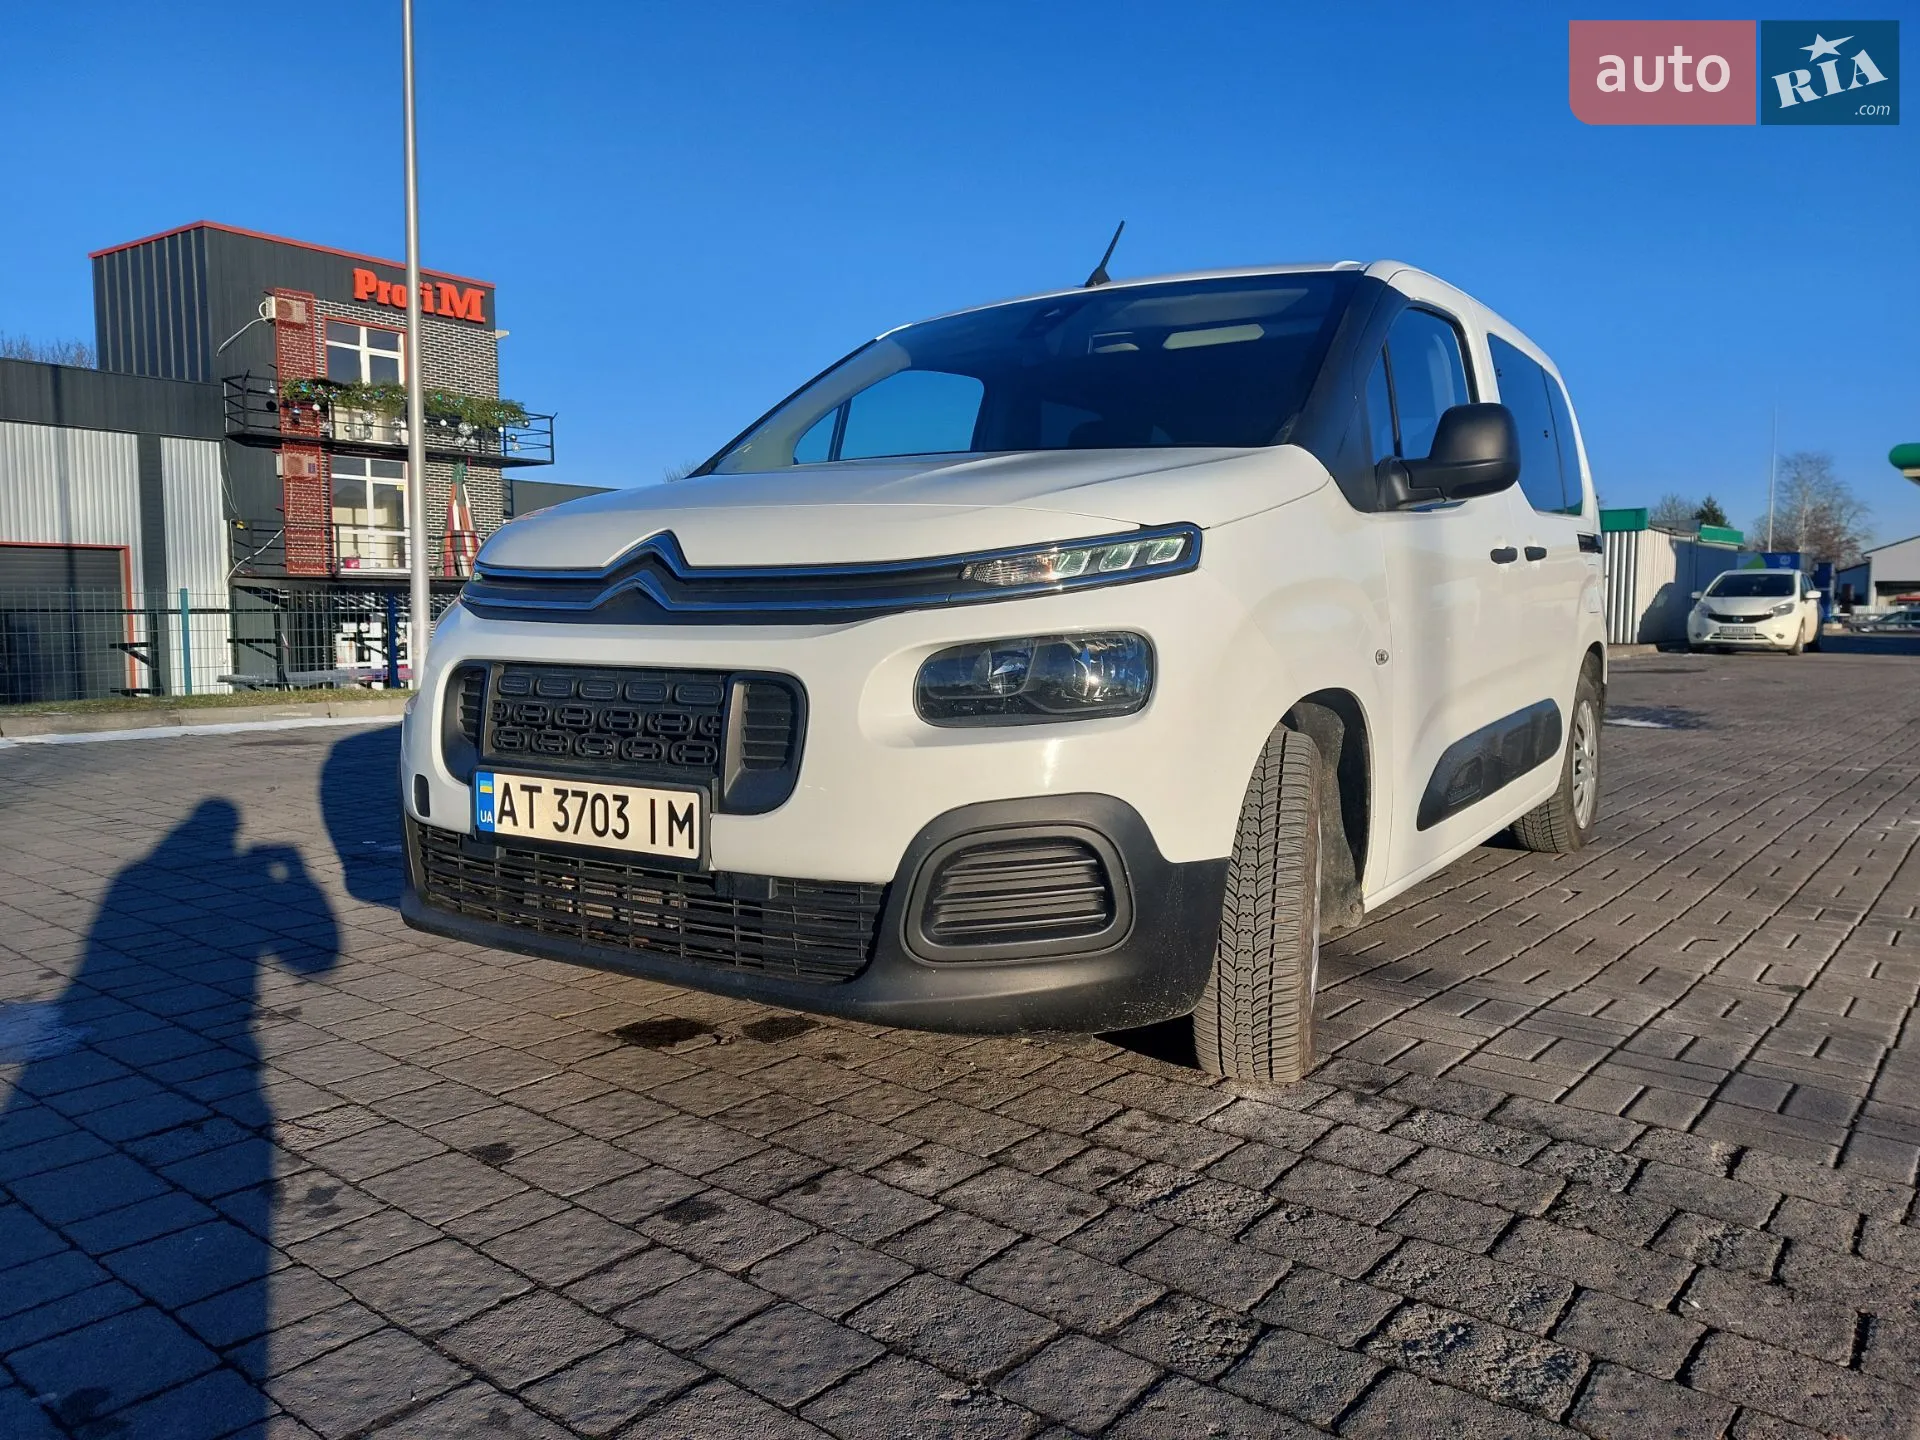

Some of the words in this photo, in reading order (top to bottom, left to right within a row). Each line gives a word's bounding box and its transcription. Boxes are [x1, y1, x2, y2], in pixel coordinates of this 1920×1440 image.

[352, 267, 486, 324] ProiM
[480, 810, 493, 824] UA
[497, 782, 543, 829] AT
[552, 787, 630, 840] 3703
[649, 798, 695, 850] IM
